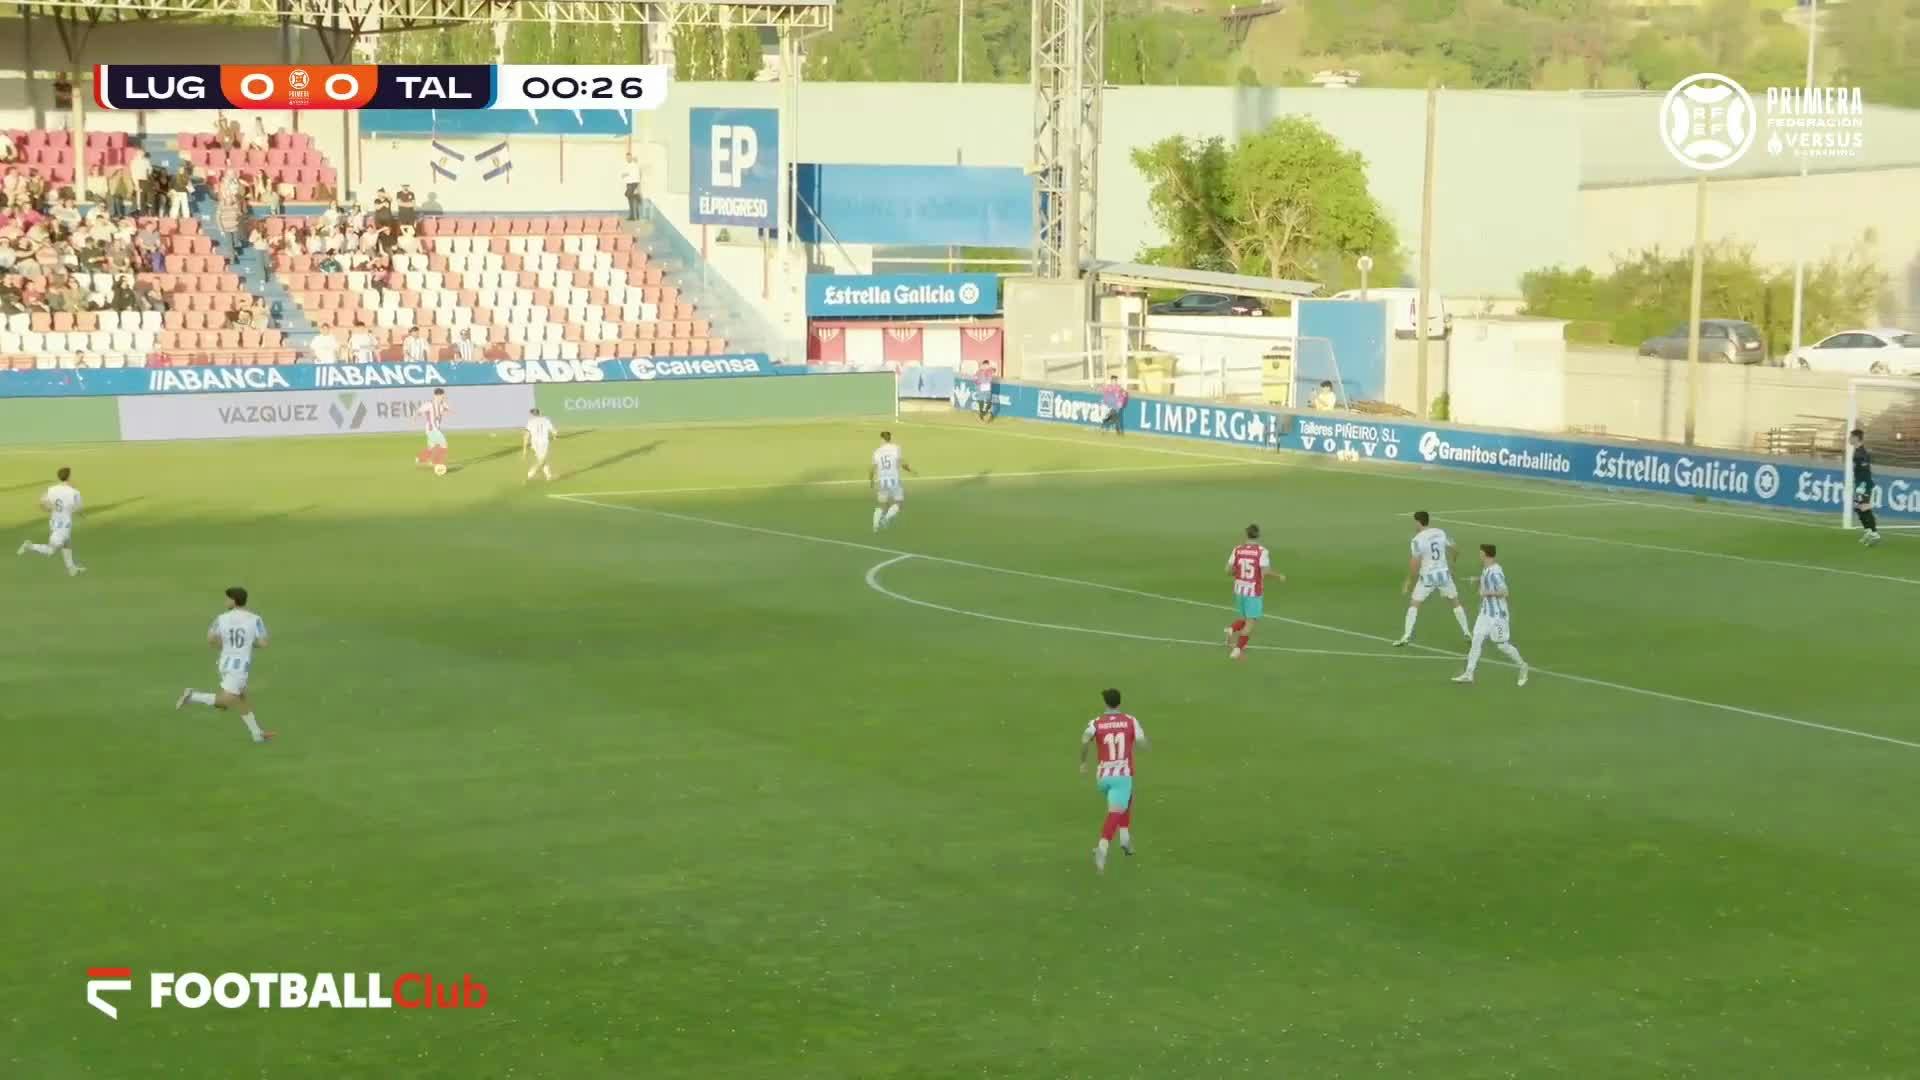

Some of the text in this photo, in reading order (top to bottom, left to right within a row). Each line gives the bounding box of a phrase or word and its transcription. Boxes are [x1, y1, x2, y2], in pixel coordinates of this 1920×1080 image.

[711, 125, 758, 188] EP
[824, 284, 956, 306] Estrella Galicia
[495, 359, 605, 384] GADIS
[218, 404, 319, 424] VAZQUEZ
[376, 400, 423, 419] REIN
[1299, 419, 1334, 438] Talleres
[1301, 434, 1398, 459] VOLVO
[1438, 441, 1571, 473] Granitos Carballido
[1593, 448, 1749, 494] Estrella Galicia
[1430, 541, 1441, 561] 5
[1238, 557, 1256, 580] 15
[228, 626, 247, 649] 16
[1103, 731, 1125, 761] 11
